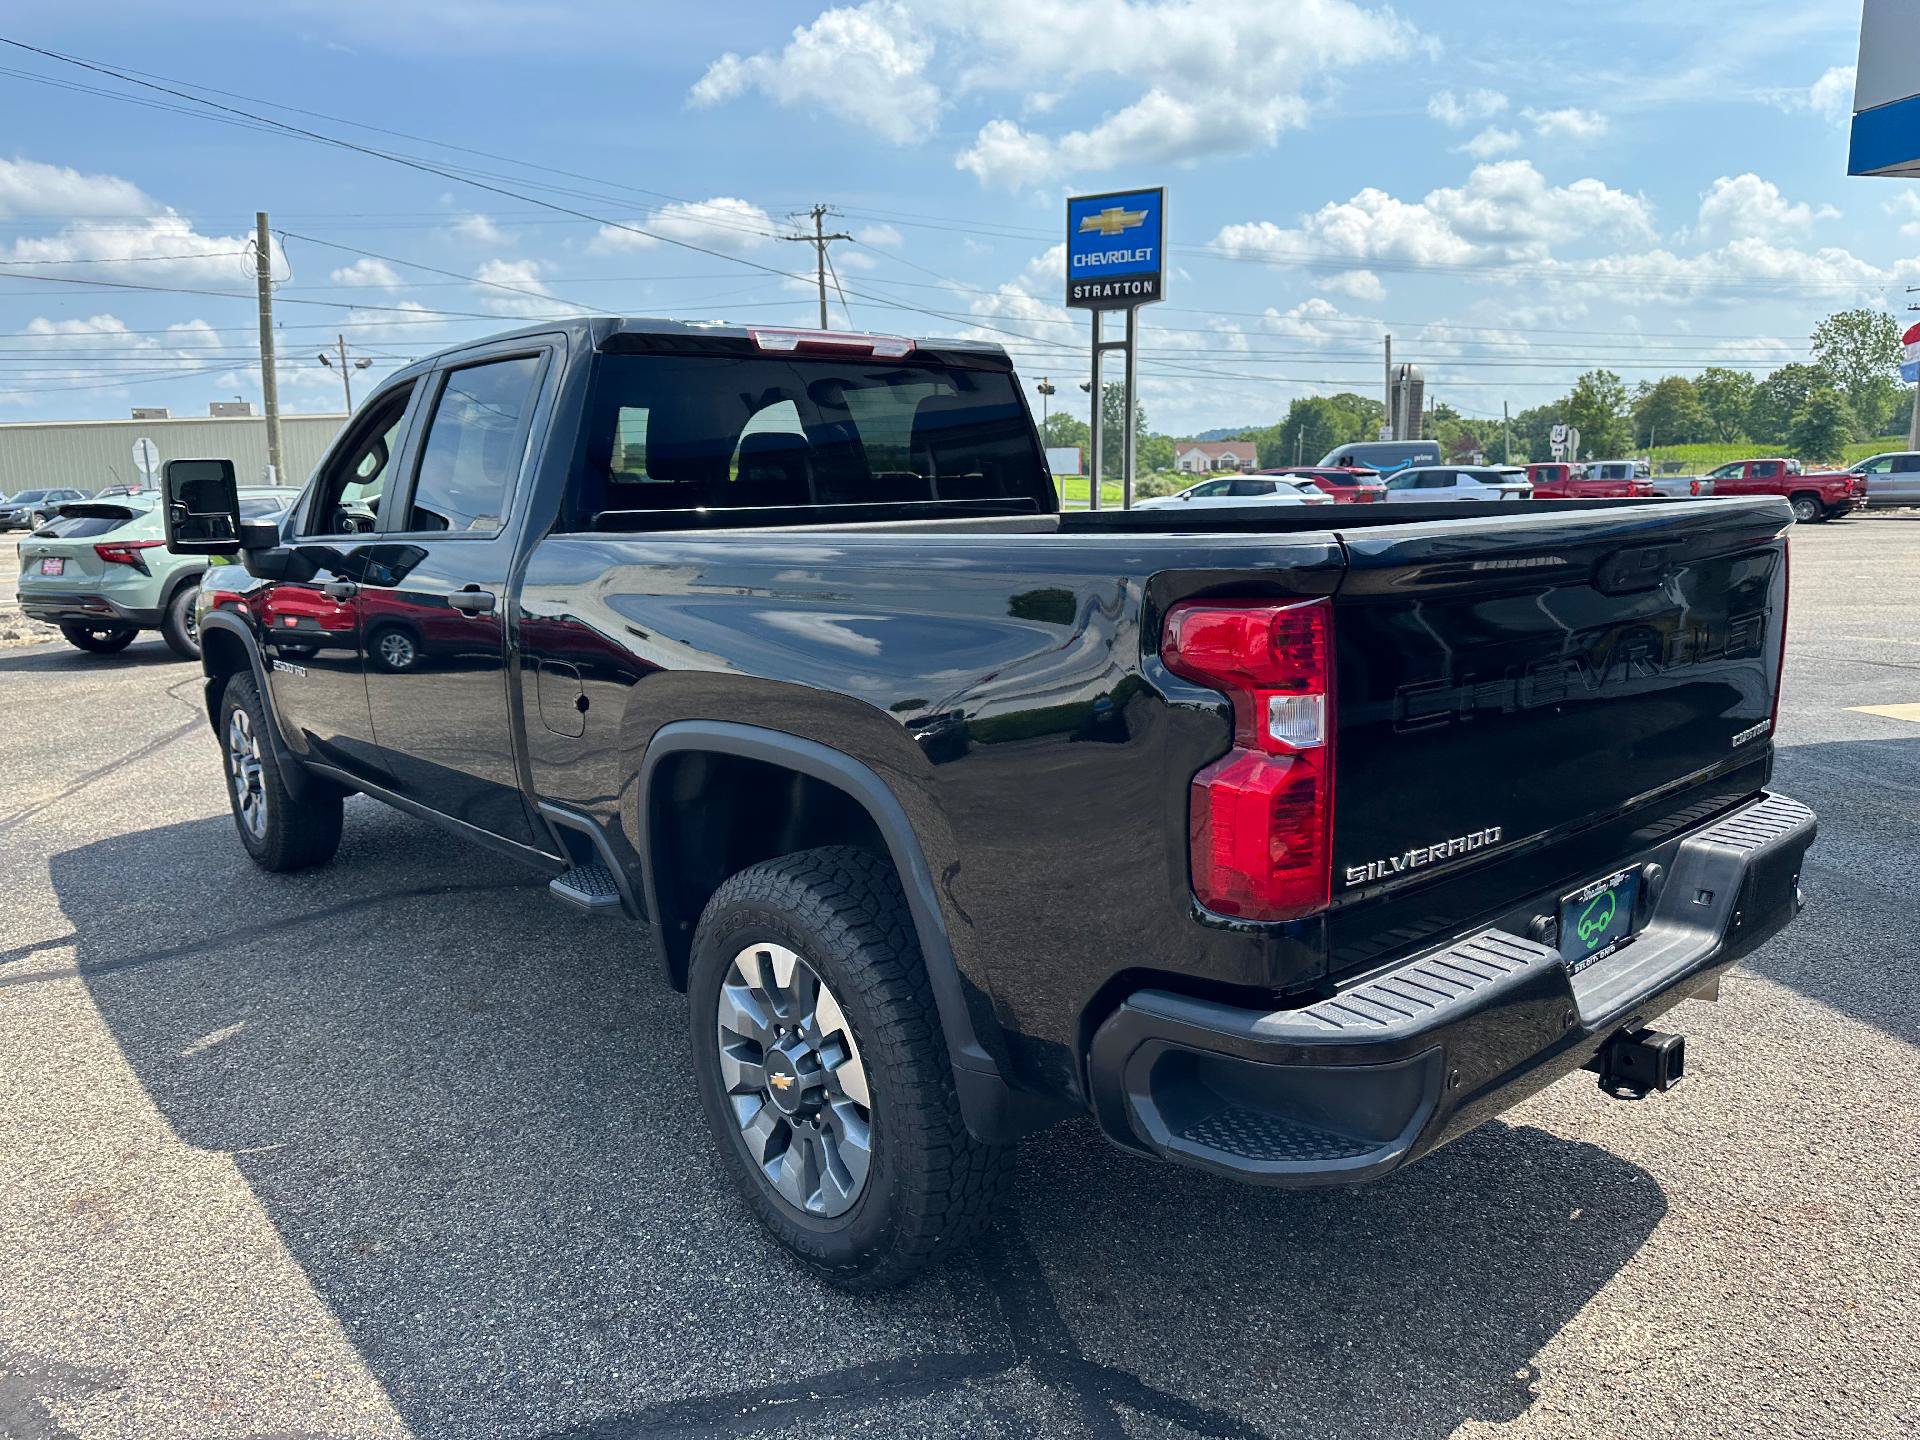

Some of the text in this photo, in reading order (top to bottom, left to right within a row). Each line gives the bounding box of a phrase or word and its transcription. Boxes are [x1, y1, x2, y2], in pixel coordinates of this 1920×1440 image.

[1073, 248, 1153, 267] CHEVROLET
[1073, 281, 1153, 299] STRATTON
[1414, 454, 1433, 463] prime
[1394, 607, 1772, 733] CHEVROLET
[1732, 719, 1771, 748] CUSTOM
[1345, 826, 1501, 887] SILVERADO
[1599, 944, 1616, 959] OHIO
